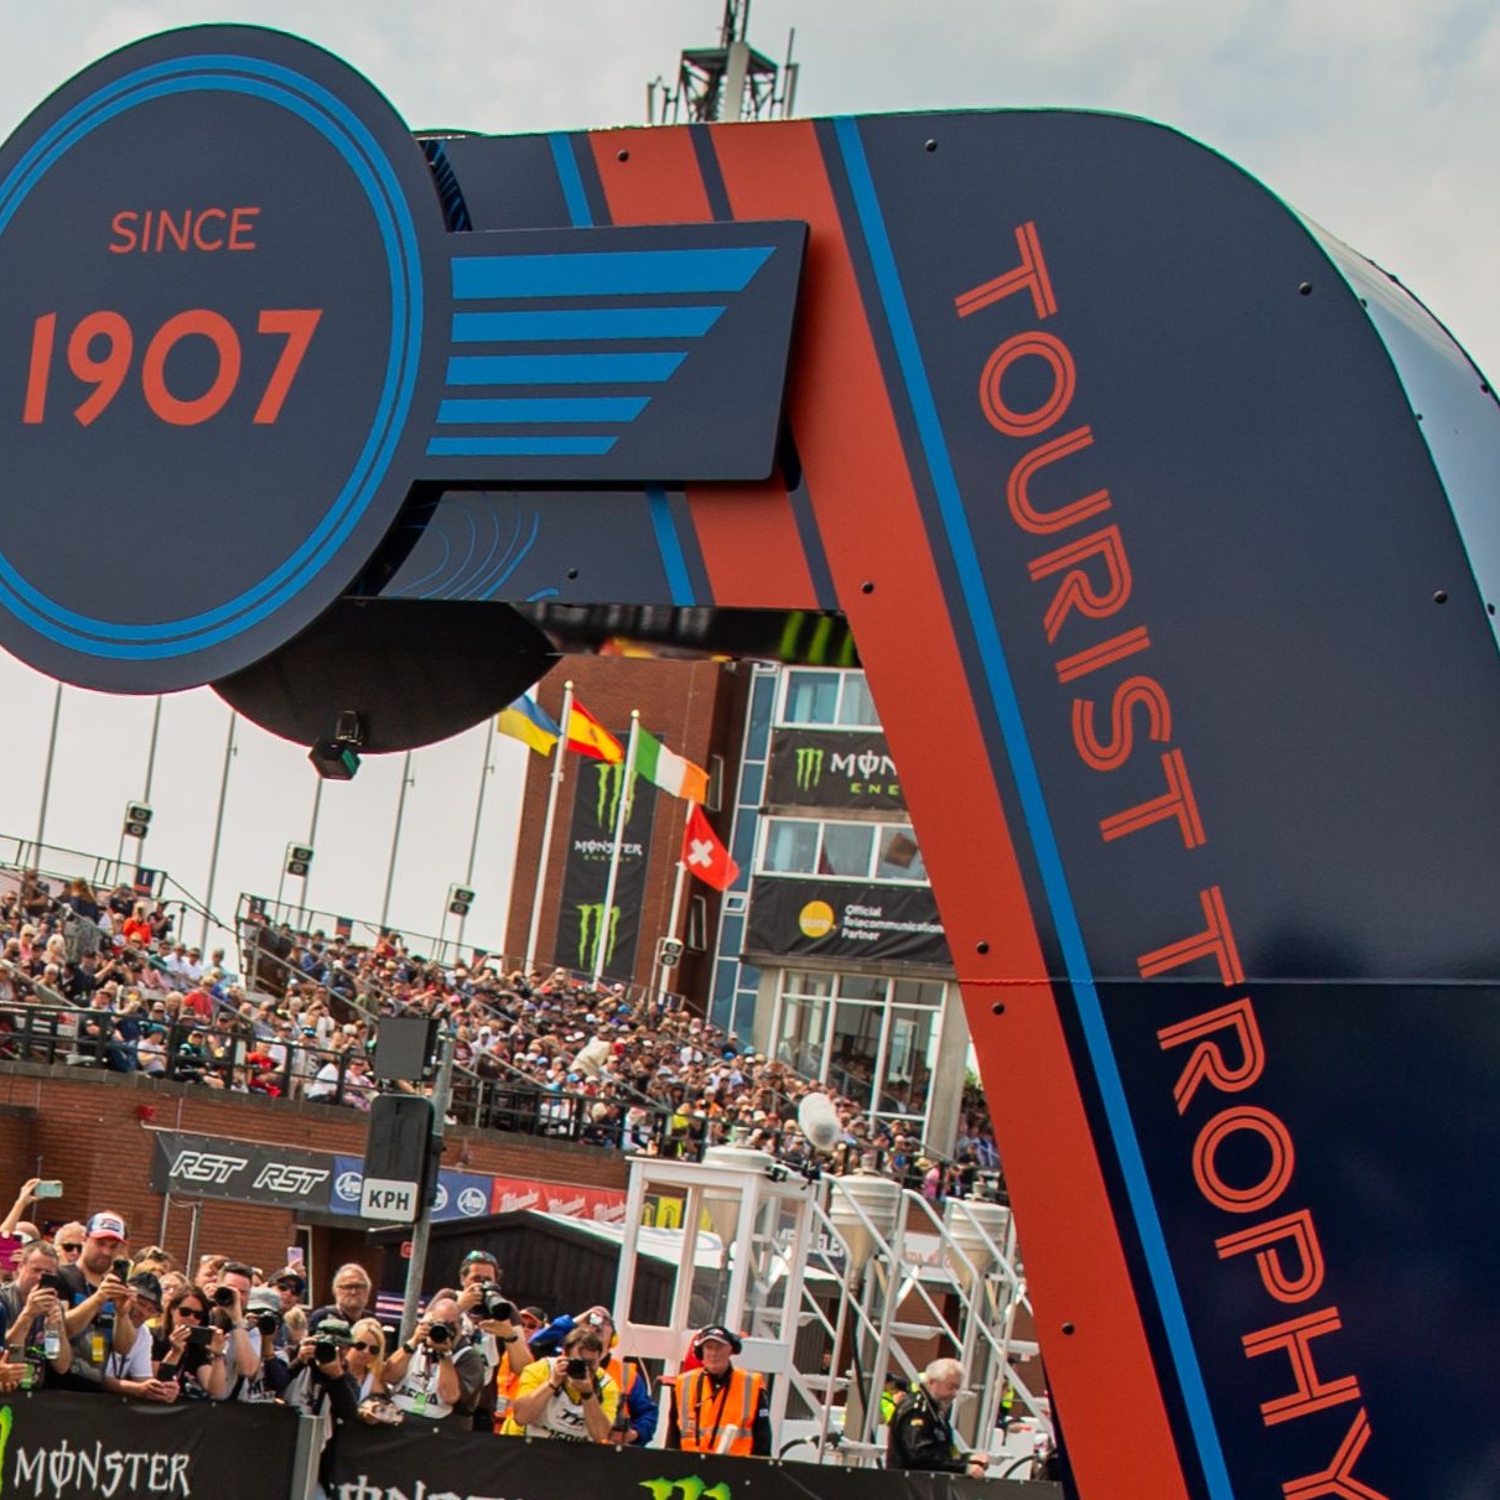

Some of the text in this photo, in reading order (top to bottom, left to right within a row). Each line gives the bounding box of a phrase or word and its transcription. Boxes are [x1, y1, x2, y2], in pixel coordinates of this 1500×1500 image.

[108, 207, 260, 255] SINCE
[23, 308, 323, 428] 1907
[954, 220, 1207, 849] TOURIST
[850, 782, 899, 796] ENE
[574, 839, 643, 856] MONSER
[845, 904, 882, 917] Official
[841, 928, 880, 941] Partner
[169, 1150, 248, 1184] RST
[253, 1163, 330, 1195] RST
[368, 1189, 410, 1211] KPH
[14, 1440, 192, 1498] MONSTER
